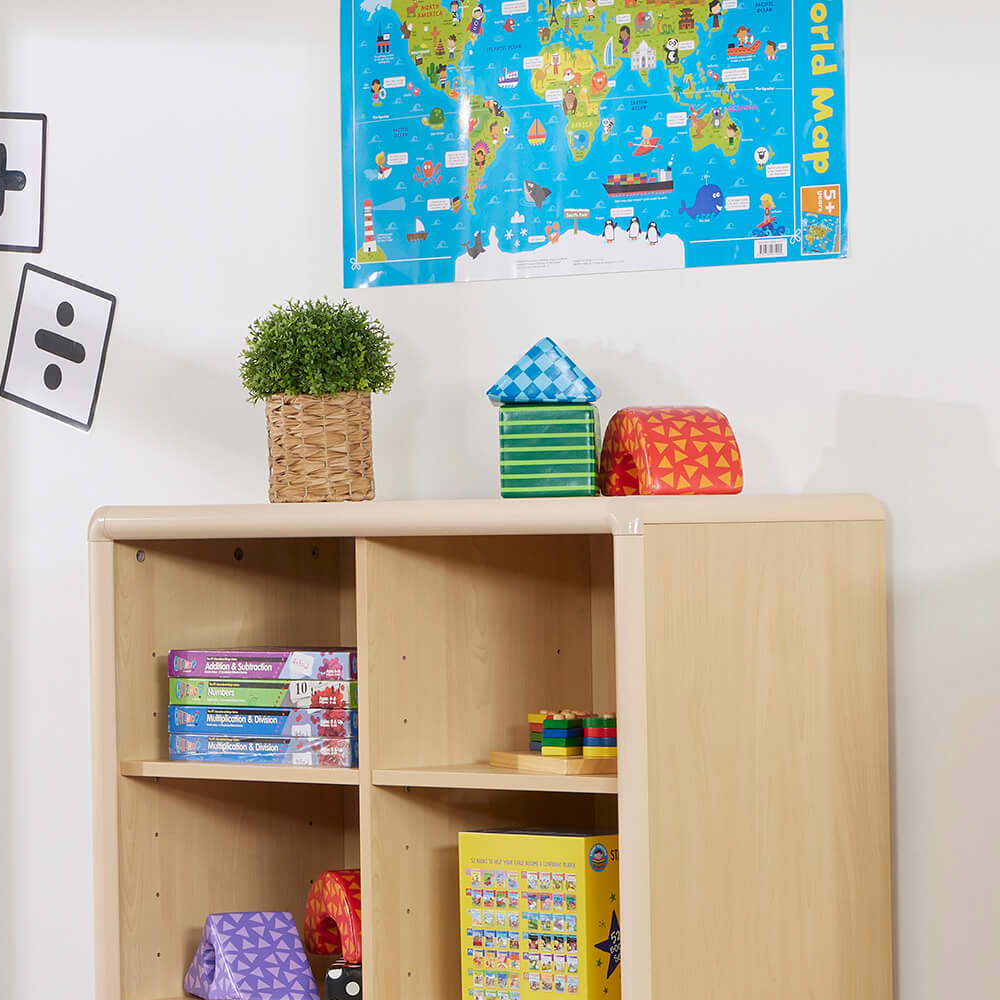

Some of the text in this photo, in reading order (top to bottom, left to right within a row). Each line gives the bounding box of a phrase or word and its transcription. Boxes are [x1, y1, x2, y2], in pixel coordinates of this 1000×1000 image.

[802, 0, 837, 174] orld Map
[728, 104, 758, 112] OCEANIA
[824, 190, 836, 213] 5+
[205, 662, 230, 671] Addition
[238, 663, 272, 671] Subtraction
[207, 688, 235, 697] Numbers
[296, 682, 308, 695] 10
[206, 714, 247, 724] Multiplication
[255, 716, 278, 724] Division
[208, 742, 248, 752] Multiplication
[256, 743, 279, 752] Division
